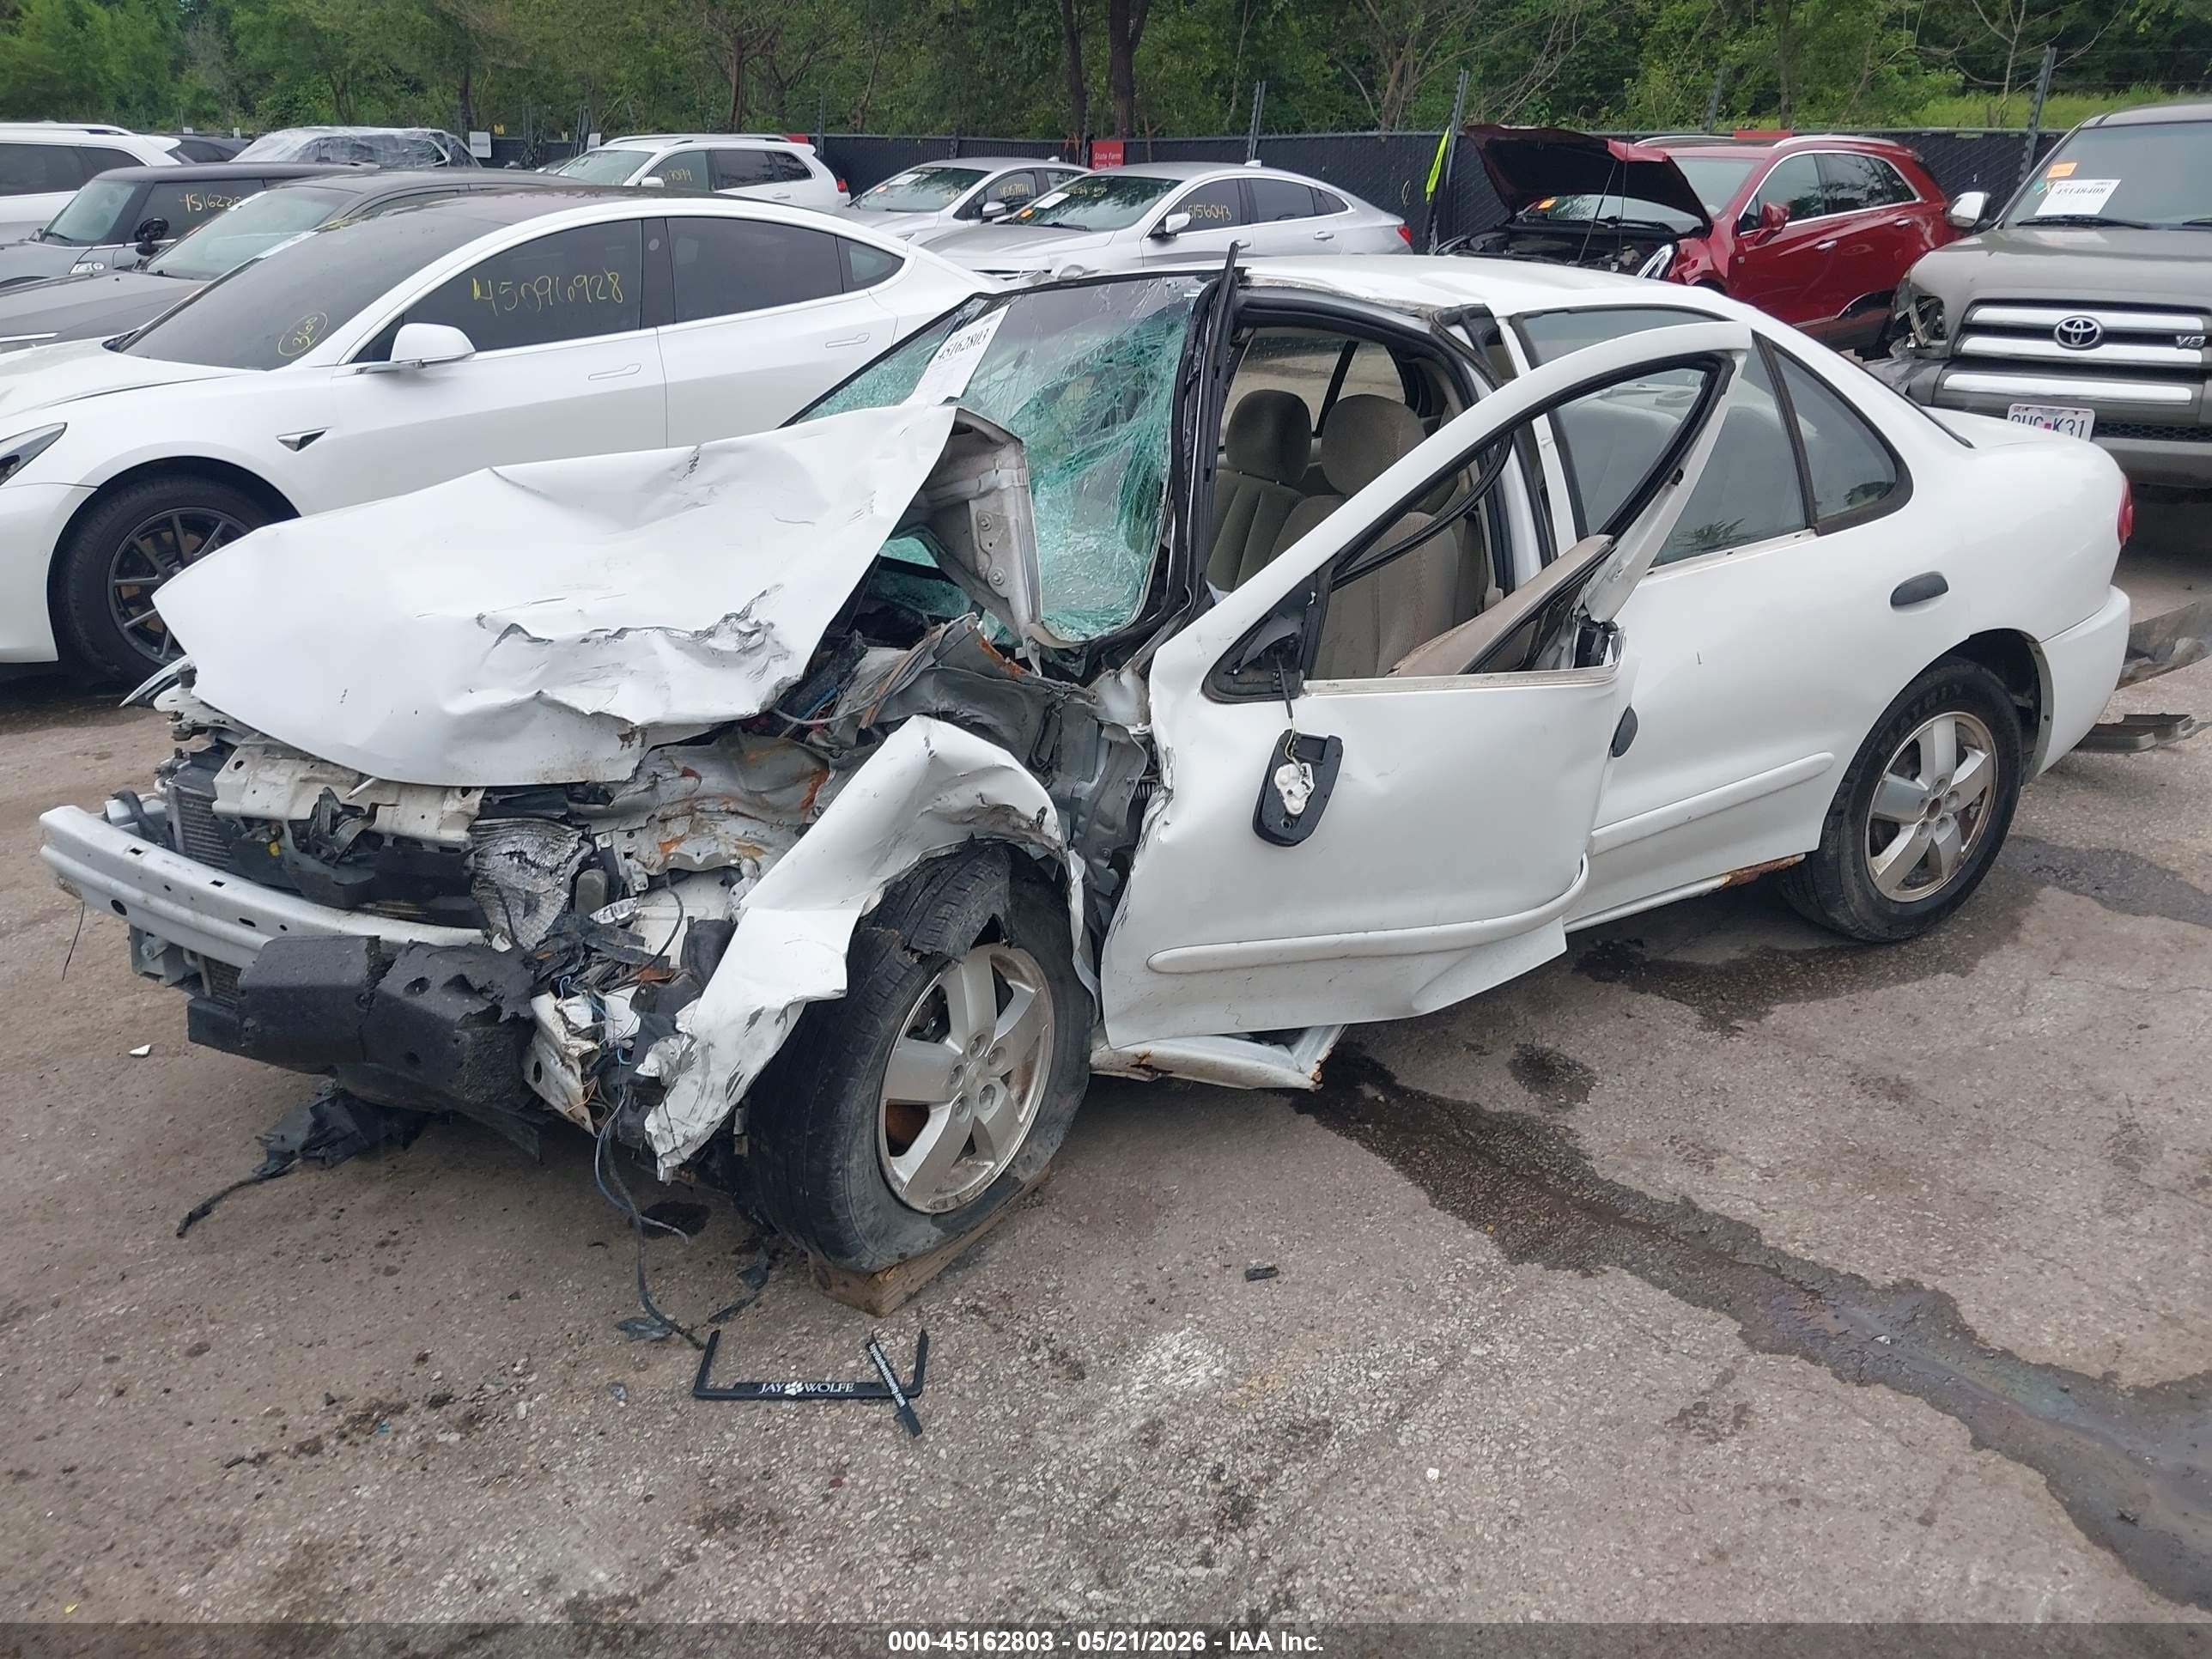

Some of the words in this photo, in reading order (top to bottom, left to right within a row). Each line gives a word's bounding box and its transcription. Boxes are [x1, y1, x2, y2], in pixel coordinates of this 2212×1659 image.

[472, 268, 623, 316] 45096928
[758, 1382, 785, 1395] JAY
[804, 1382, 855, 1394] WOLFE
